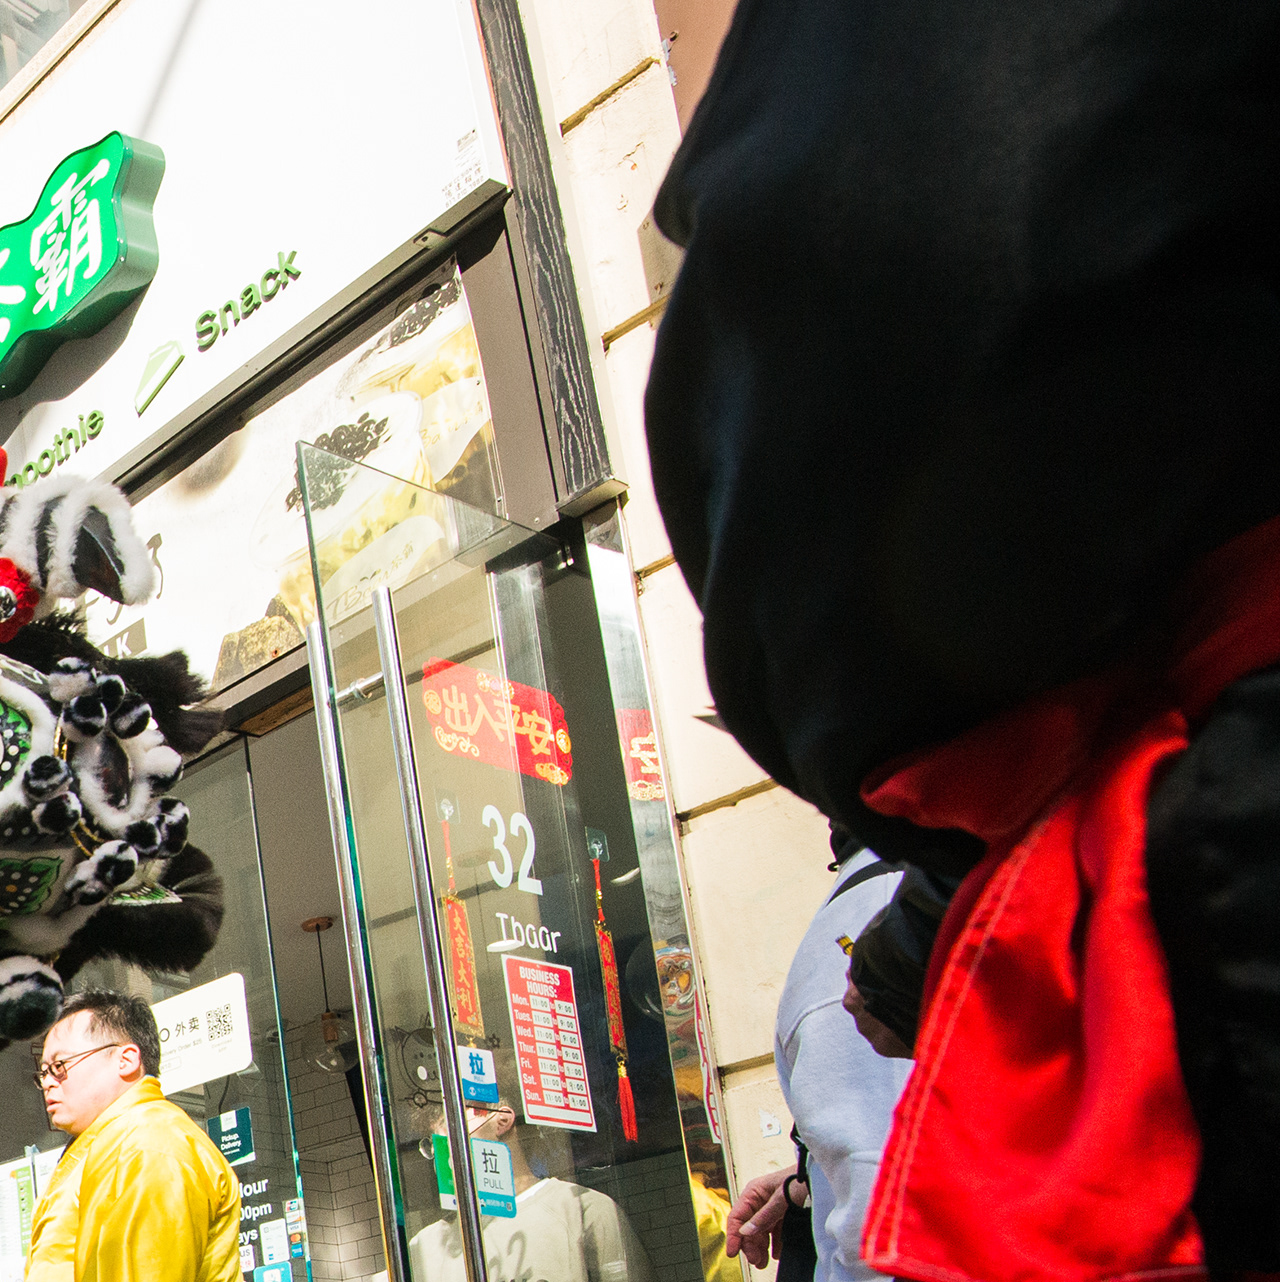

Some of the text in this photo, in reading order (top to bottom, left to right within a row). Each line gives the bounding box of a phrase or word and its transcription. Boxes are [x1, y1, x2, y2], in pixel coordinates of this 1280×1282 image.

[196, 250, 301, 352] Snack
[442, 685, 554, 756] 出入平安
[482, 804, 543, 896] 32
[453, 908, 474, 1013] 大吉大利
[519, 966, 560, 986] BUSINESS
[526, 981, 557, 998] HOURS:
[512, 994, 529, 1006] Mon.
[514, 1010, 532, 1022] Tues.
[174, 1016, 200, 1038] 外卖
[516, 1026, 534, 1037] Wed.
[518, 1041, 535, 1053] Thur.
[469, 1052, 485, 1076] 拉
[521, 1058, 532, 1068] Fri.
[523, 1073, 537, 1085] Sat.
[526, 1089, 541, 1101] Sun.
[482, 1148, 500, 1174] 拉
[484, 1178, 504, 1190] PULL
